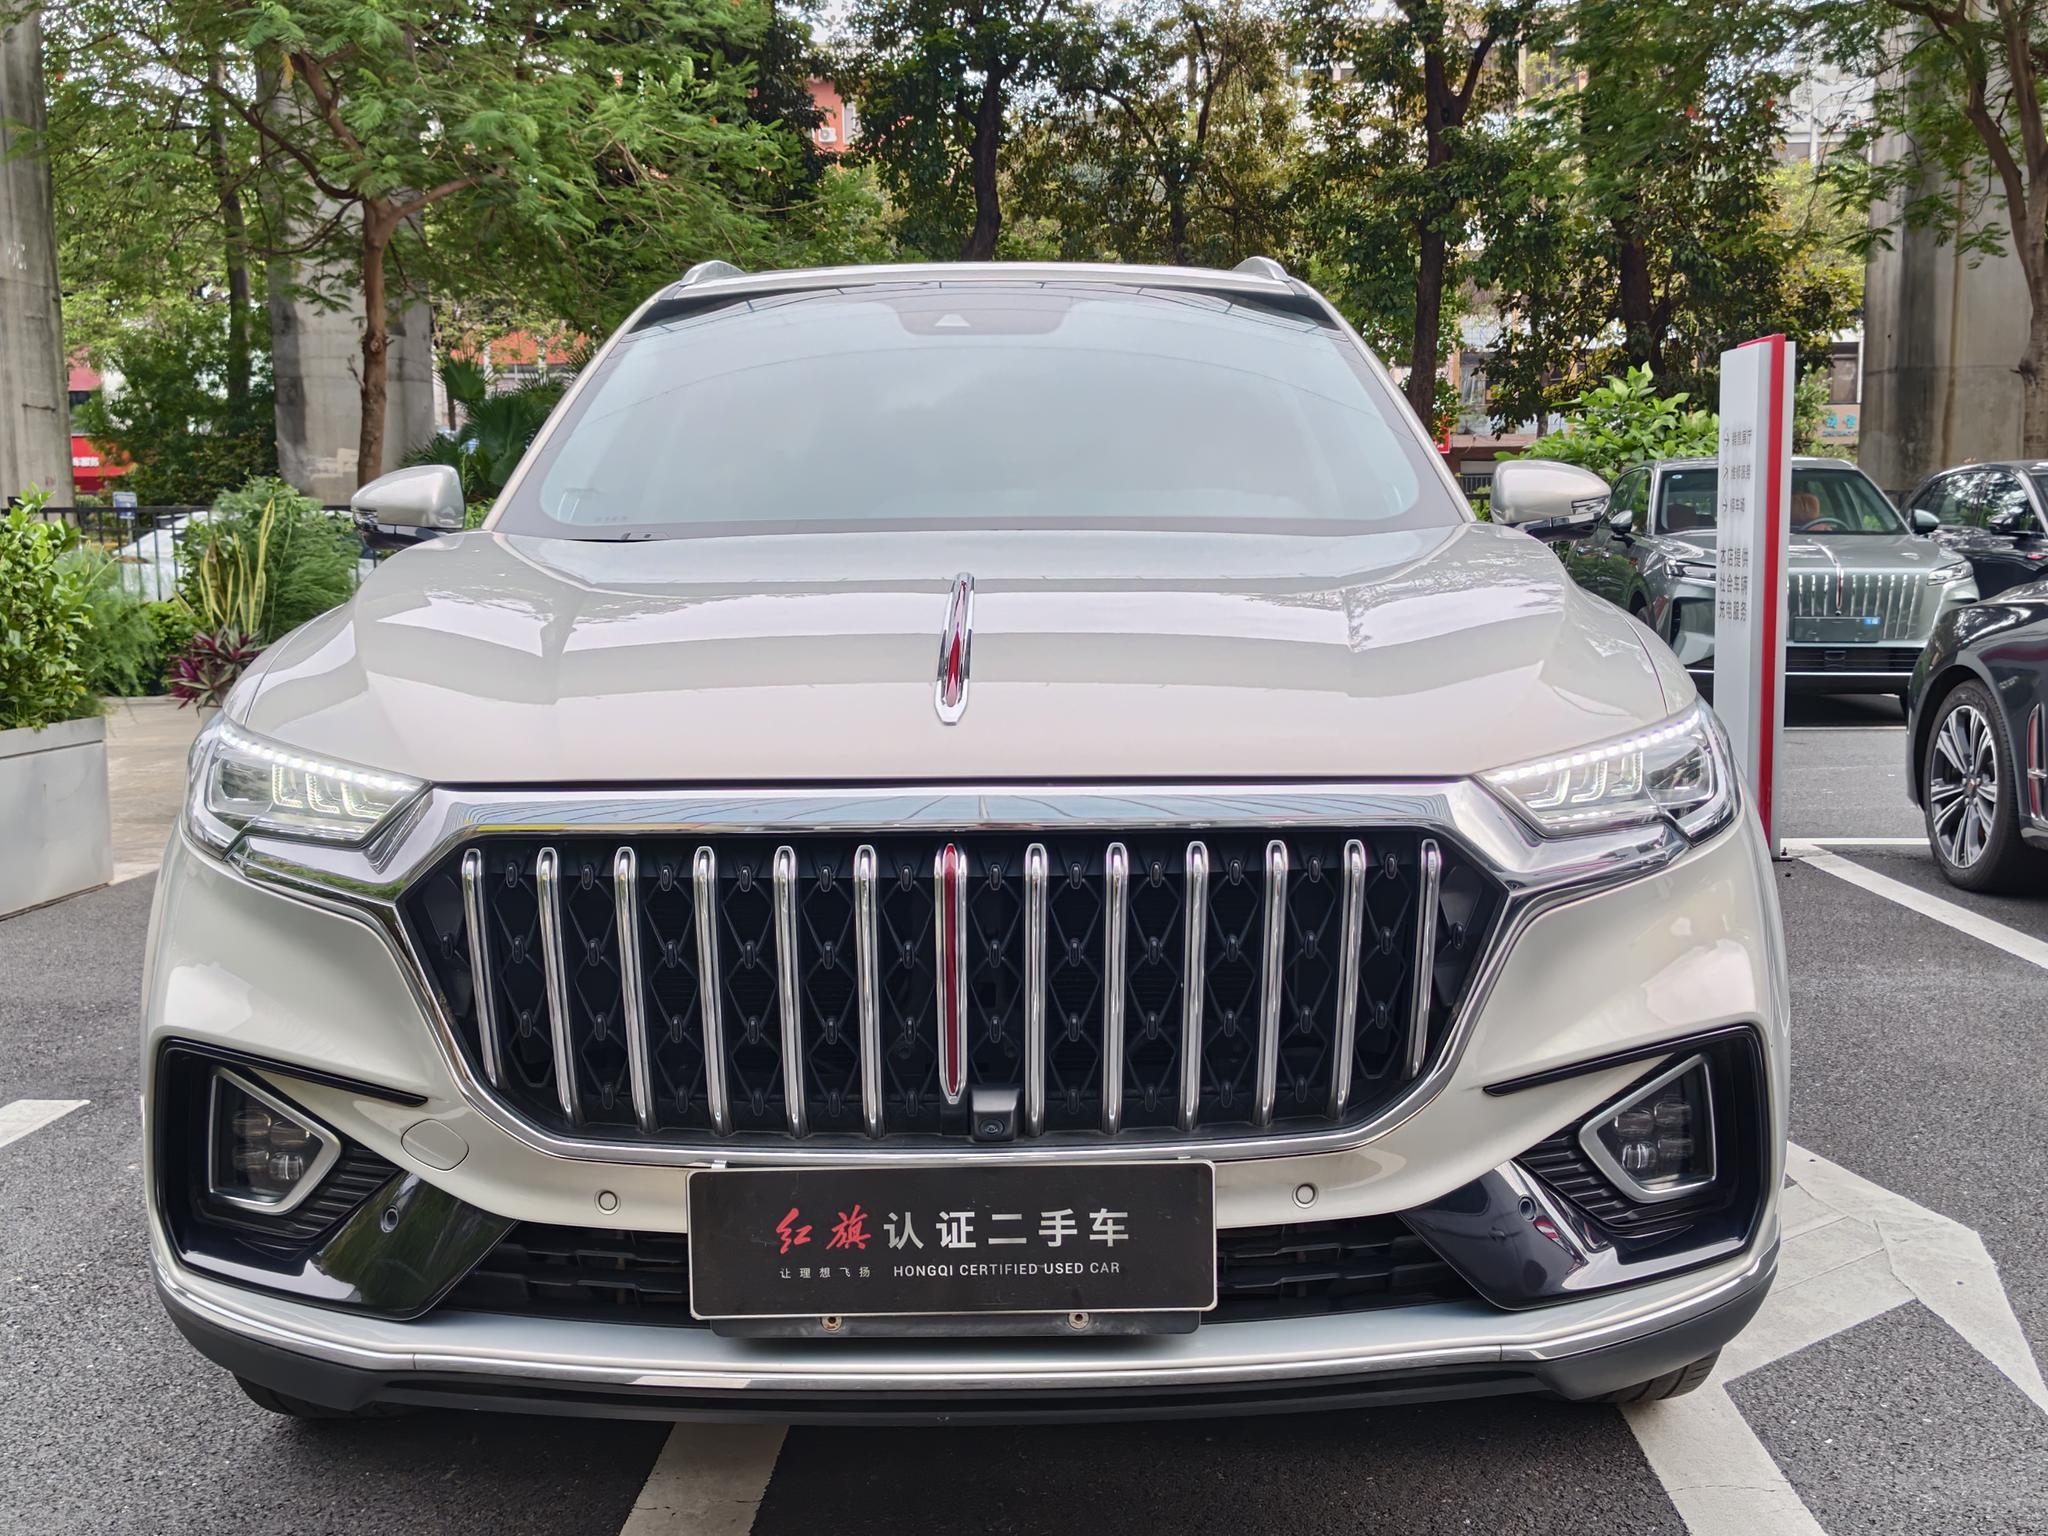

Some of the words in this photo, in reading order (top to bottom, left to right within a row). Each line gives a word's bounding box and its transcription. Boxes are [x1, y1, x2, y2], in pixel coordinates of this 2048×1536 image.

[1720, 547, 1749, 568] 本店提供
[1720, 574, 1748, 595] 社会车辆
[775, 1204, 872, 1255] 红旗
[883, 1207, 1129, 1250] 认证二手车
[779, 1265, 872, 1280] 让理想飞扬
[893, 1264, 954, 1278] HONGQI
[959, 1263, 1038, 1276] CERTIFIED
[1043, 1262, 1084, 1275] USED
[1089, 1262, 1120, 1274] CAR
